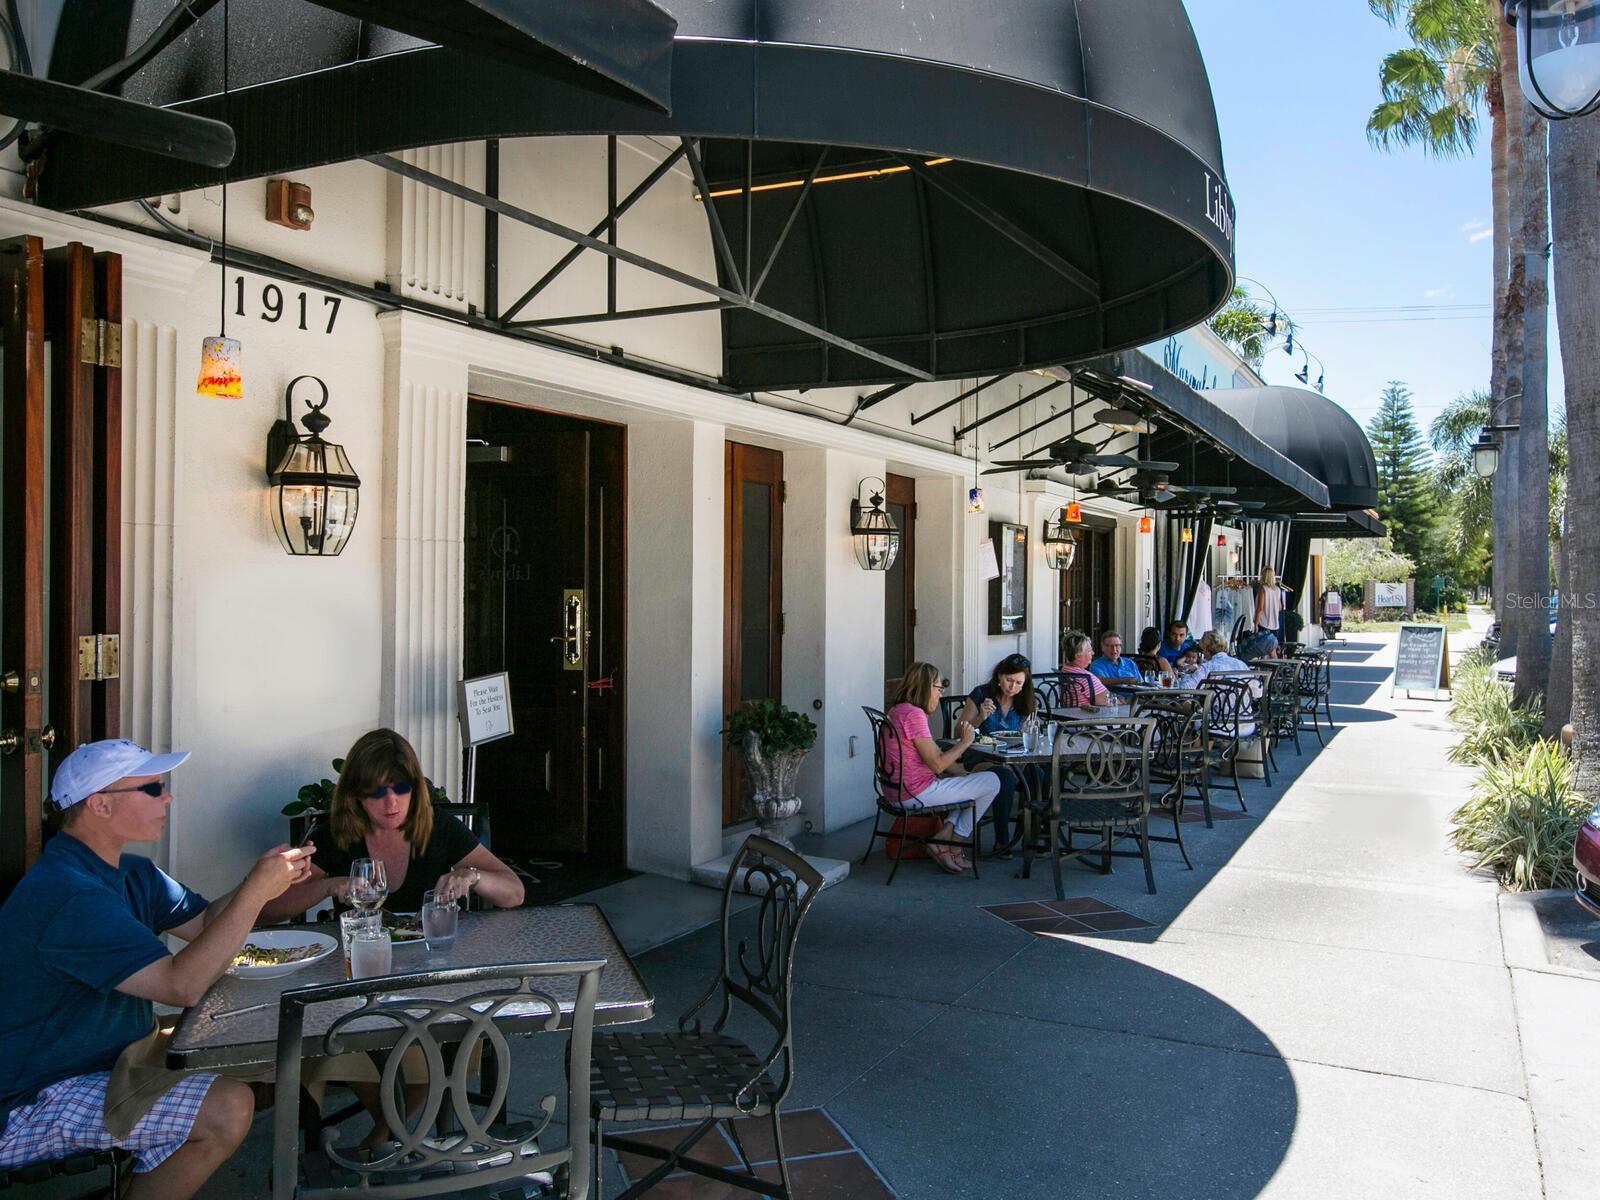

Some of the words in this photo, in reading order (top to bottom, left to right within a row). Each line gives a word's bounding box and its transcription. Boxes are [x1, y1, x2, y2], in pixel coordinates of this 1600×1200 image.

[234, 276, 342, 334] 1917
[473, 689, 488, 697] Please
[478, 697, 487, 705] the
[482, 705, 492, 714] Seat
